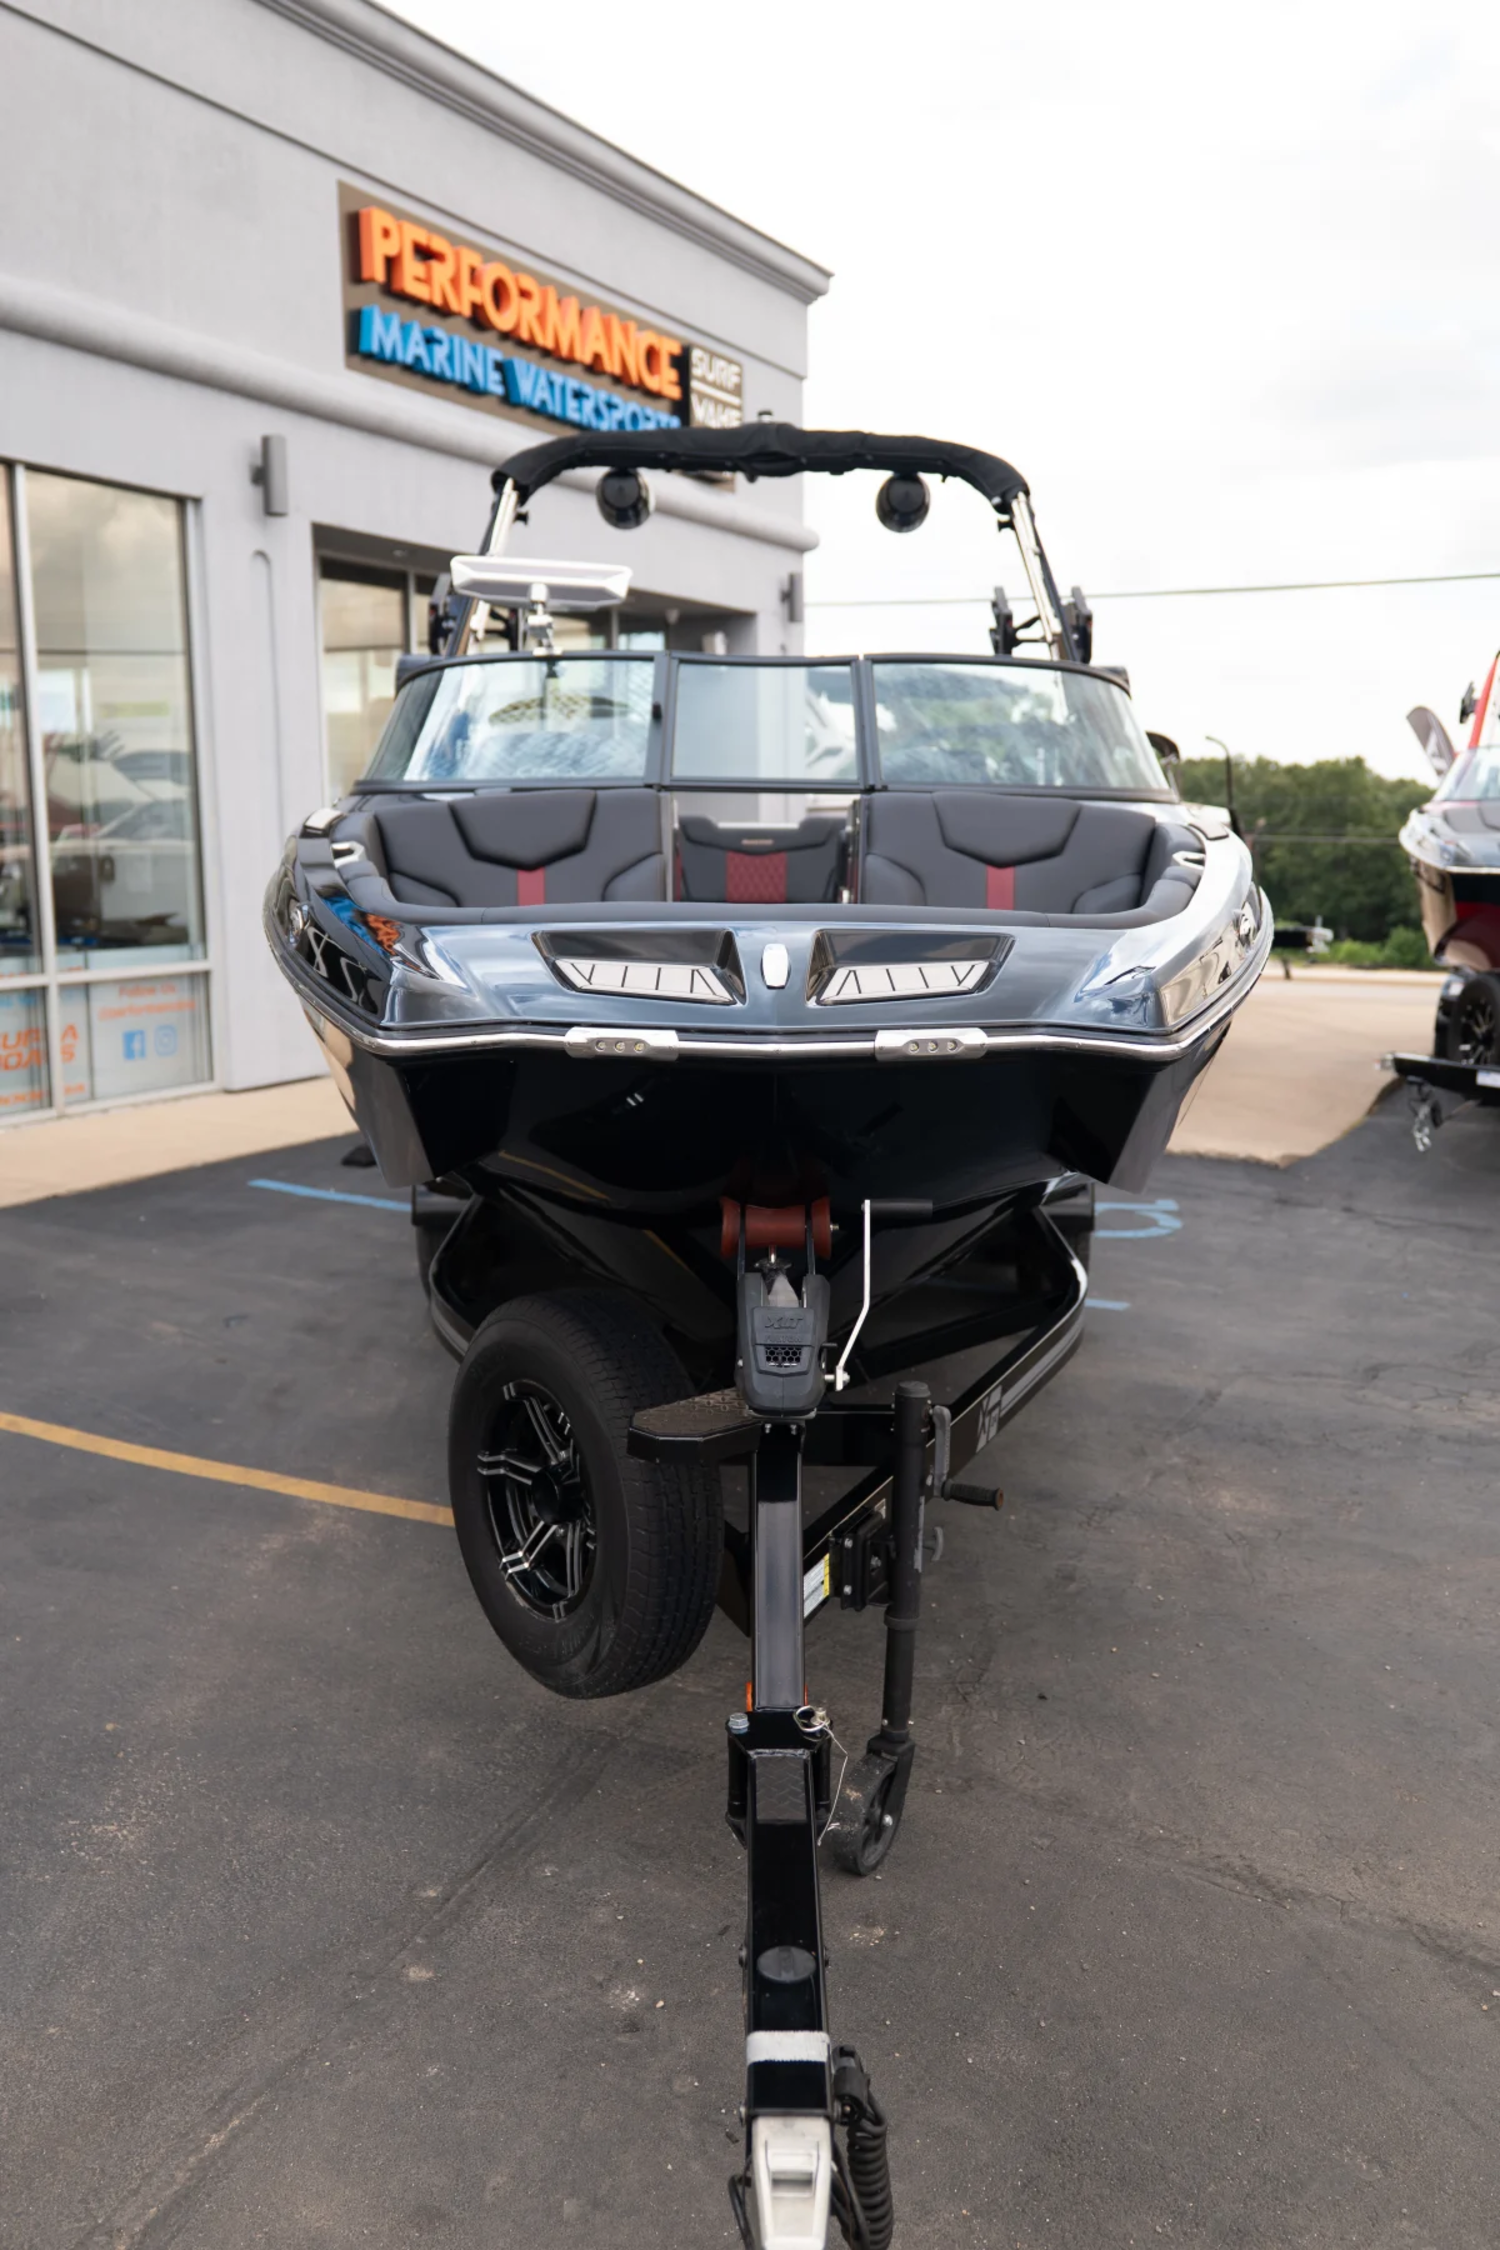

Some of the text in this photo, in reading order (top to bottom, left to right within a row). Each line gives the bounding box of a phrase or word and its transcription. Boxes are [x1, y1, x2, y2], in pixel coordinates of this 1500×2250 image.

[359, 206, 682, 400] PERFORMANCE
[359, 304, 505, 396] MARINE
[690, 348, 742, 391] SURF
